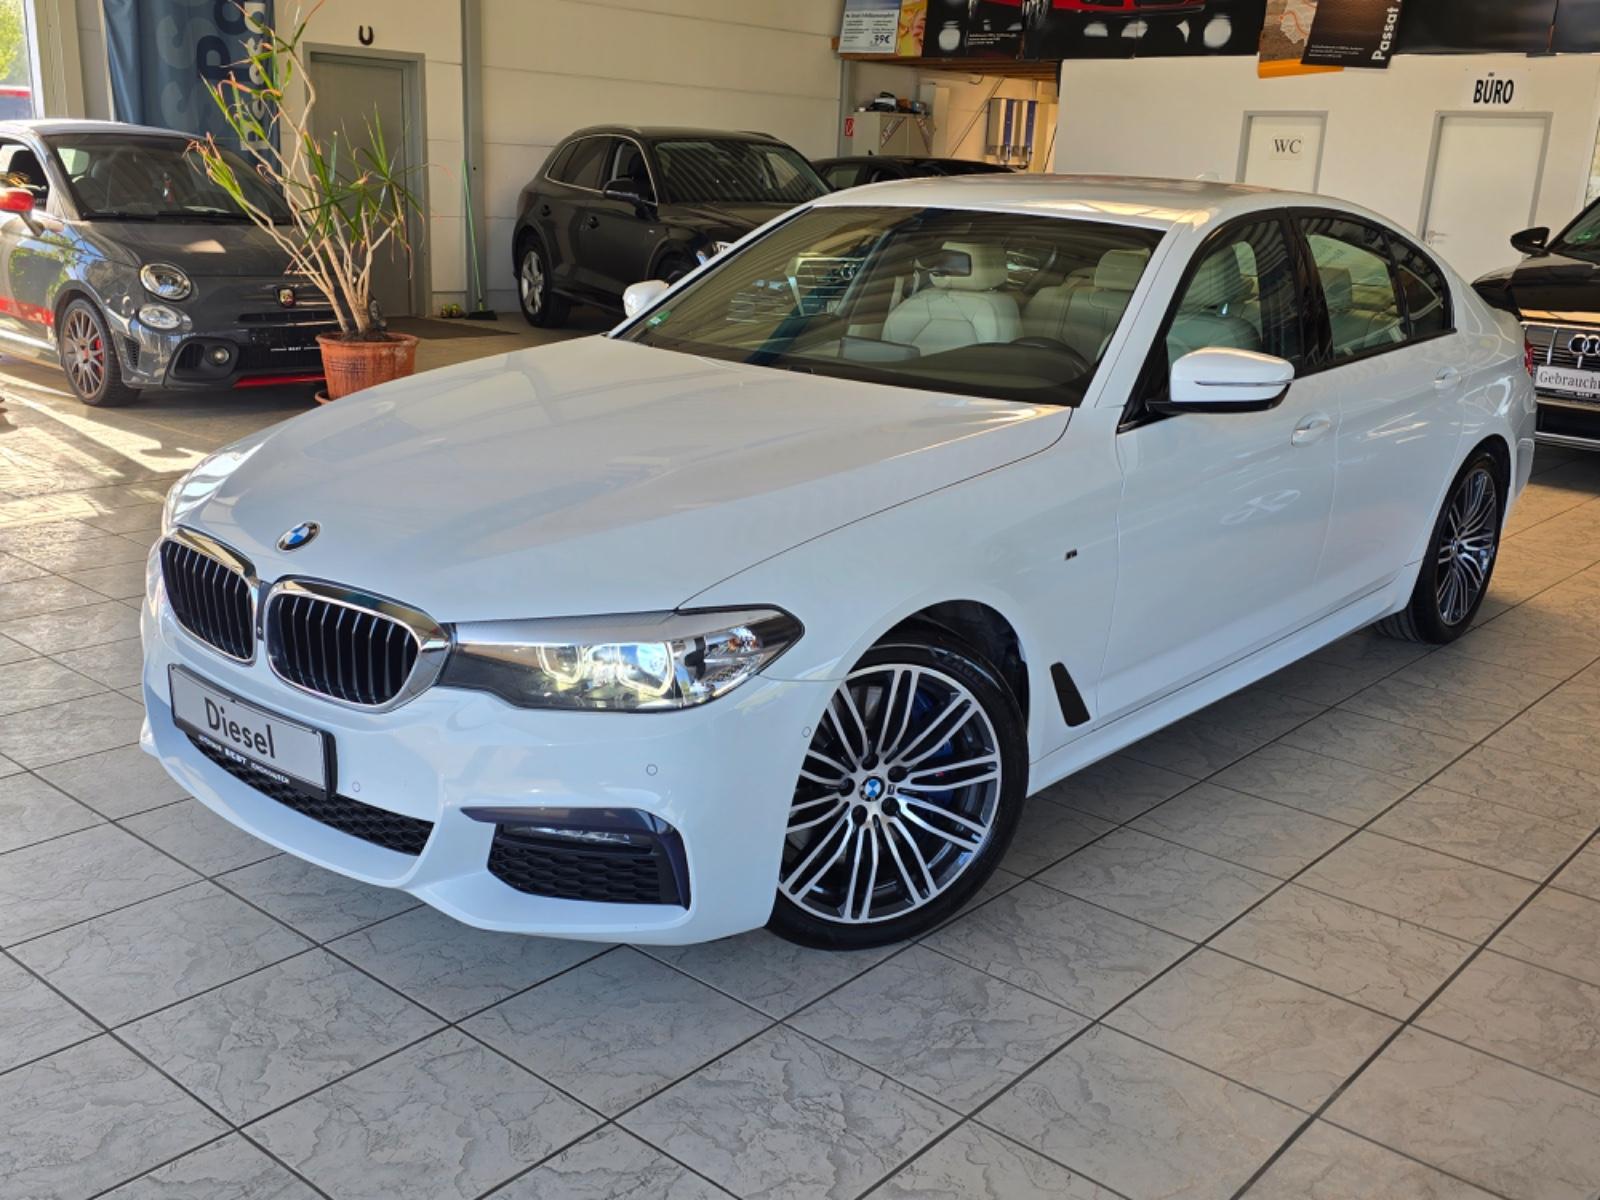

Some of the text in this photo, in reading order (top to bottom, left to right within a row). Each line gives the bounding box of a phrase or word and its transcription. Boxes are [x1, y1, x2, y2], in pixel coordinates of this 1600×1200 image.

[1371, 7, 1400, 60] Passat
[1473, 72, 1515, 104] BÜRO
[1274, 139, 1301, 154] WC
[1540, 370, 1600, 390] Gebrauch
[204, 697, 275, 759] Diesel
